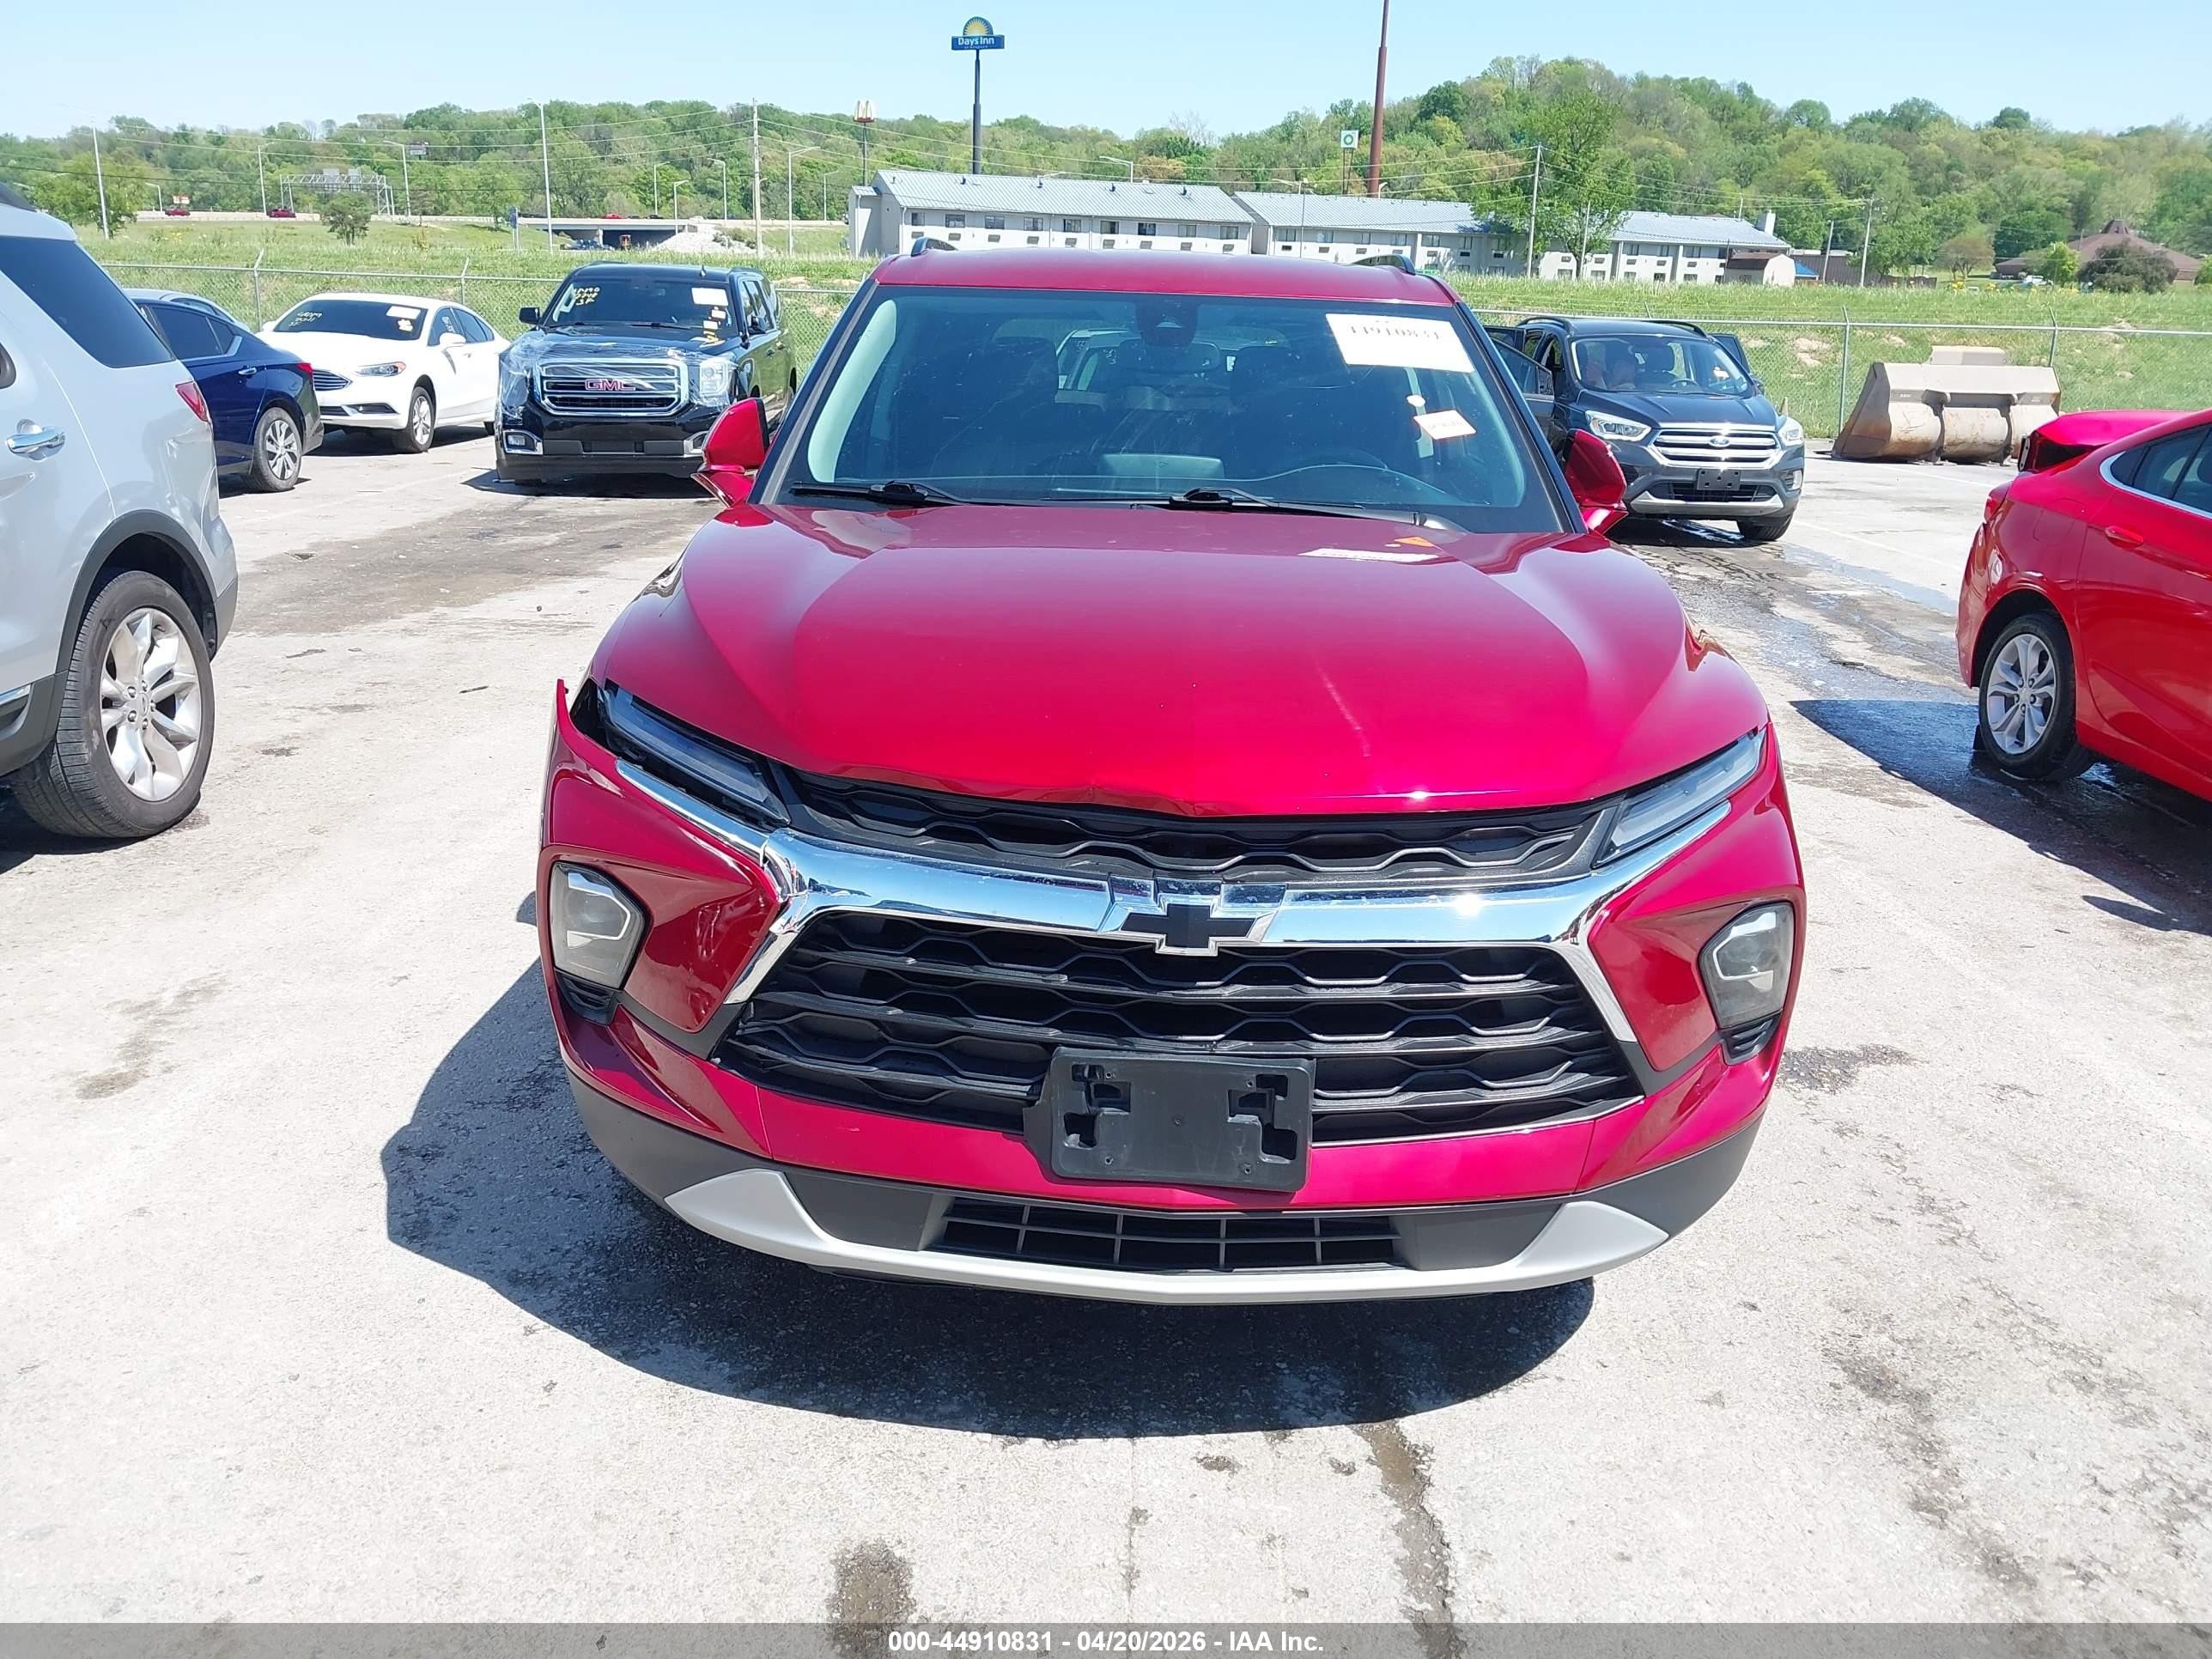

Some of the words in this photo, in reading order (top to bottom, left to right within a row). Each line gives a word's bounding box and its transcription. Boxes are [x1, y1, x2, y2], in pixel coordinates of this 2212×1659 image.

[957, 37, 979, 46] Days
[980, 36, 994, 45] Inn
[585, 378, 635, 391] GMC
